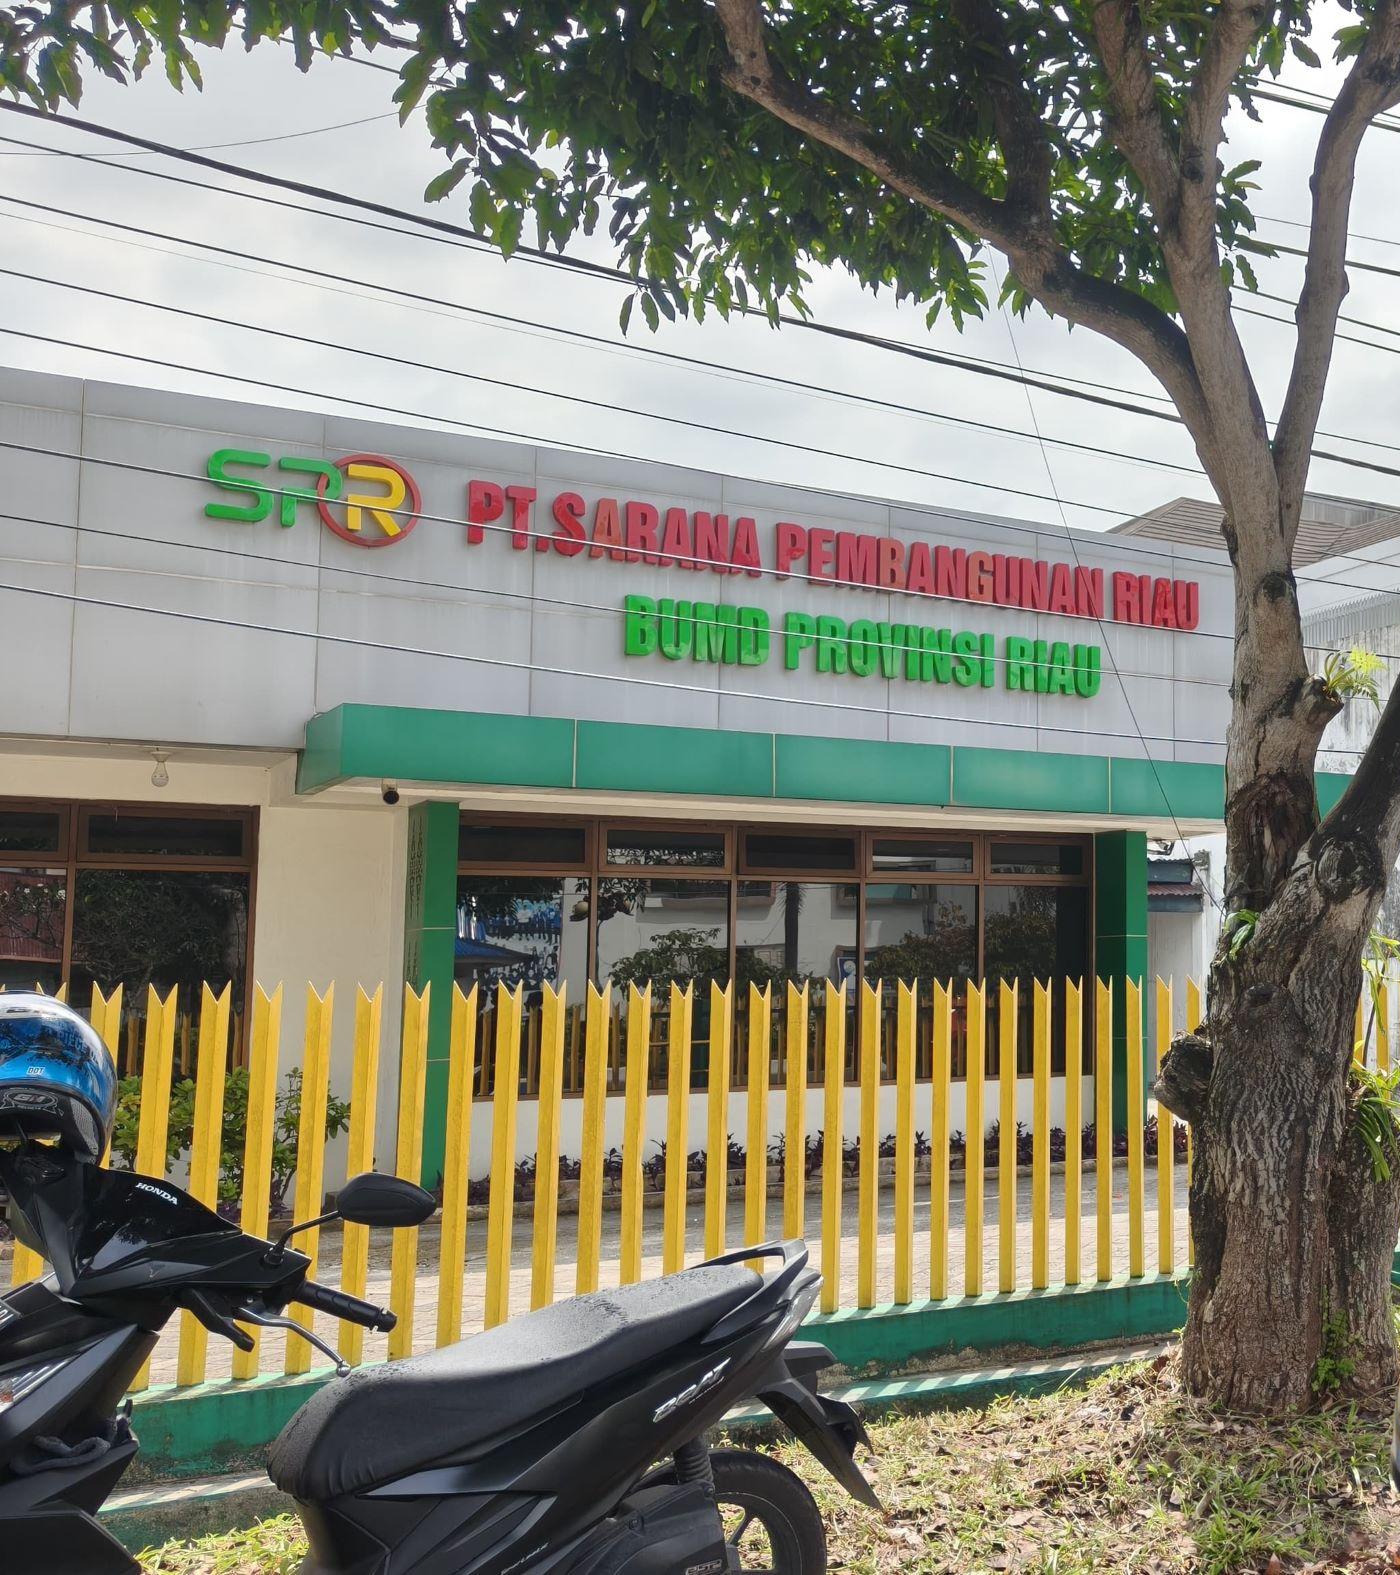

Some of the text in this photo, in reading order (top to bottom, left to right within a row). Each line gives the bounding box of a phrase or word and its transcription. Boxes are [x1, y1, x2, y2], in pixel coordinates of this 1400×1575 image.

[205, 448, 406, 537] SPR
[776, 522, 1104, 621] PEMBANGUNAN
[1112, 571, 1199, 631] RIAU
[624, 594, 1101, 698] BUMD PROVINSI RIAU
[27, 1066, 45, 1075] DOT
[135, 1182, 178, 1206] HONDA
